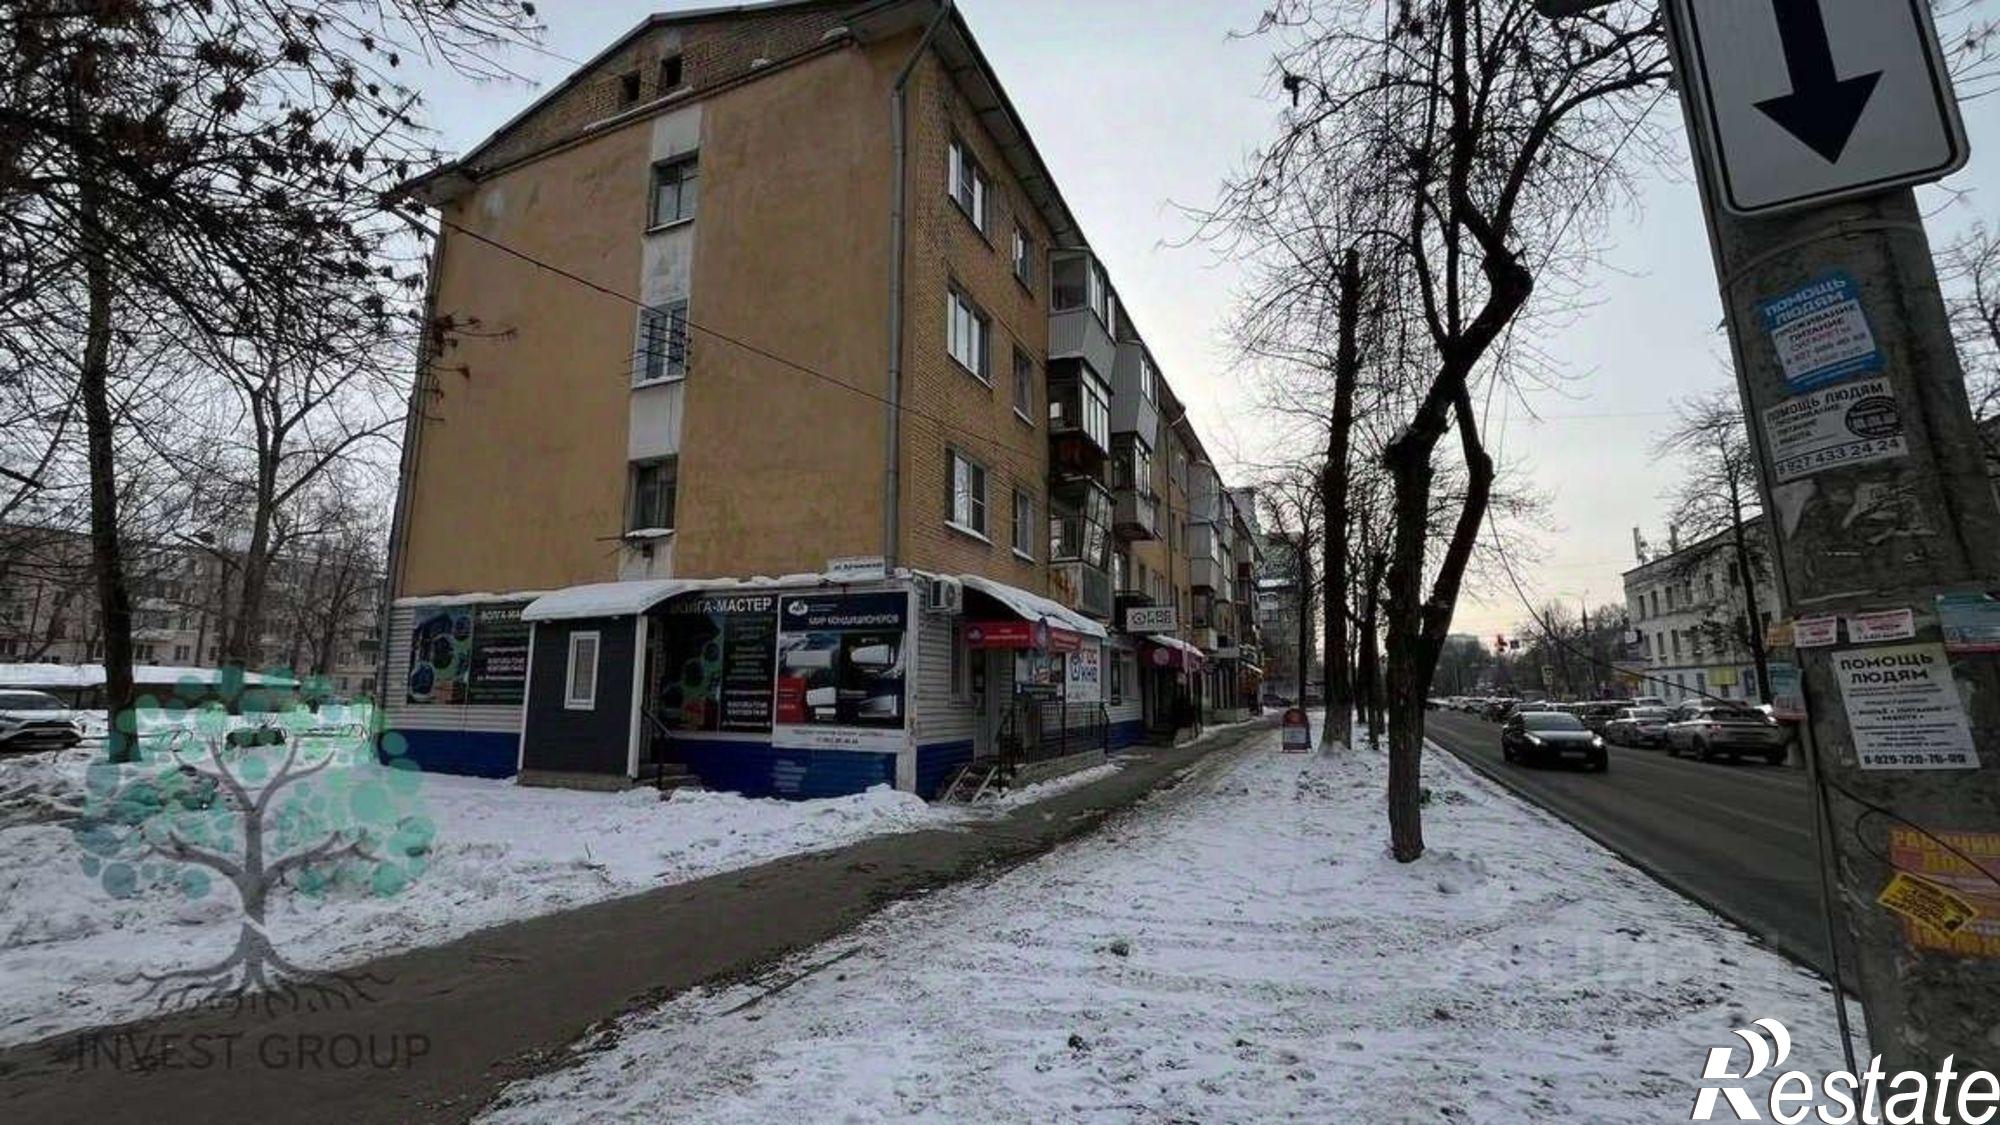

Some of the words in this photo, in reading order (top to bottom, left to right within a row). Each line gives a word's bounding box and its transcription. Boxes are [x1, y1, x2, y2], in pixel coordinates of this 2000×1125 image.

[1765, 279, 1846, 317] ПОМОЩЬ
[1776, 291, 1845, 326] ЛЮДЯМ
[1825, 383, 1884, 404] ЛЮДЯМ
[1815, 449, 1846, 464] 433
[1851, 443, 1874, 456] 24
[1878, 439, 1900, 452] 24
[1840, 653, 1933, 670] ПОМОЩЬ
[1851, 669, 1929, 684] ЛЮДЯМ
